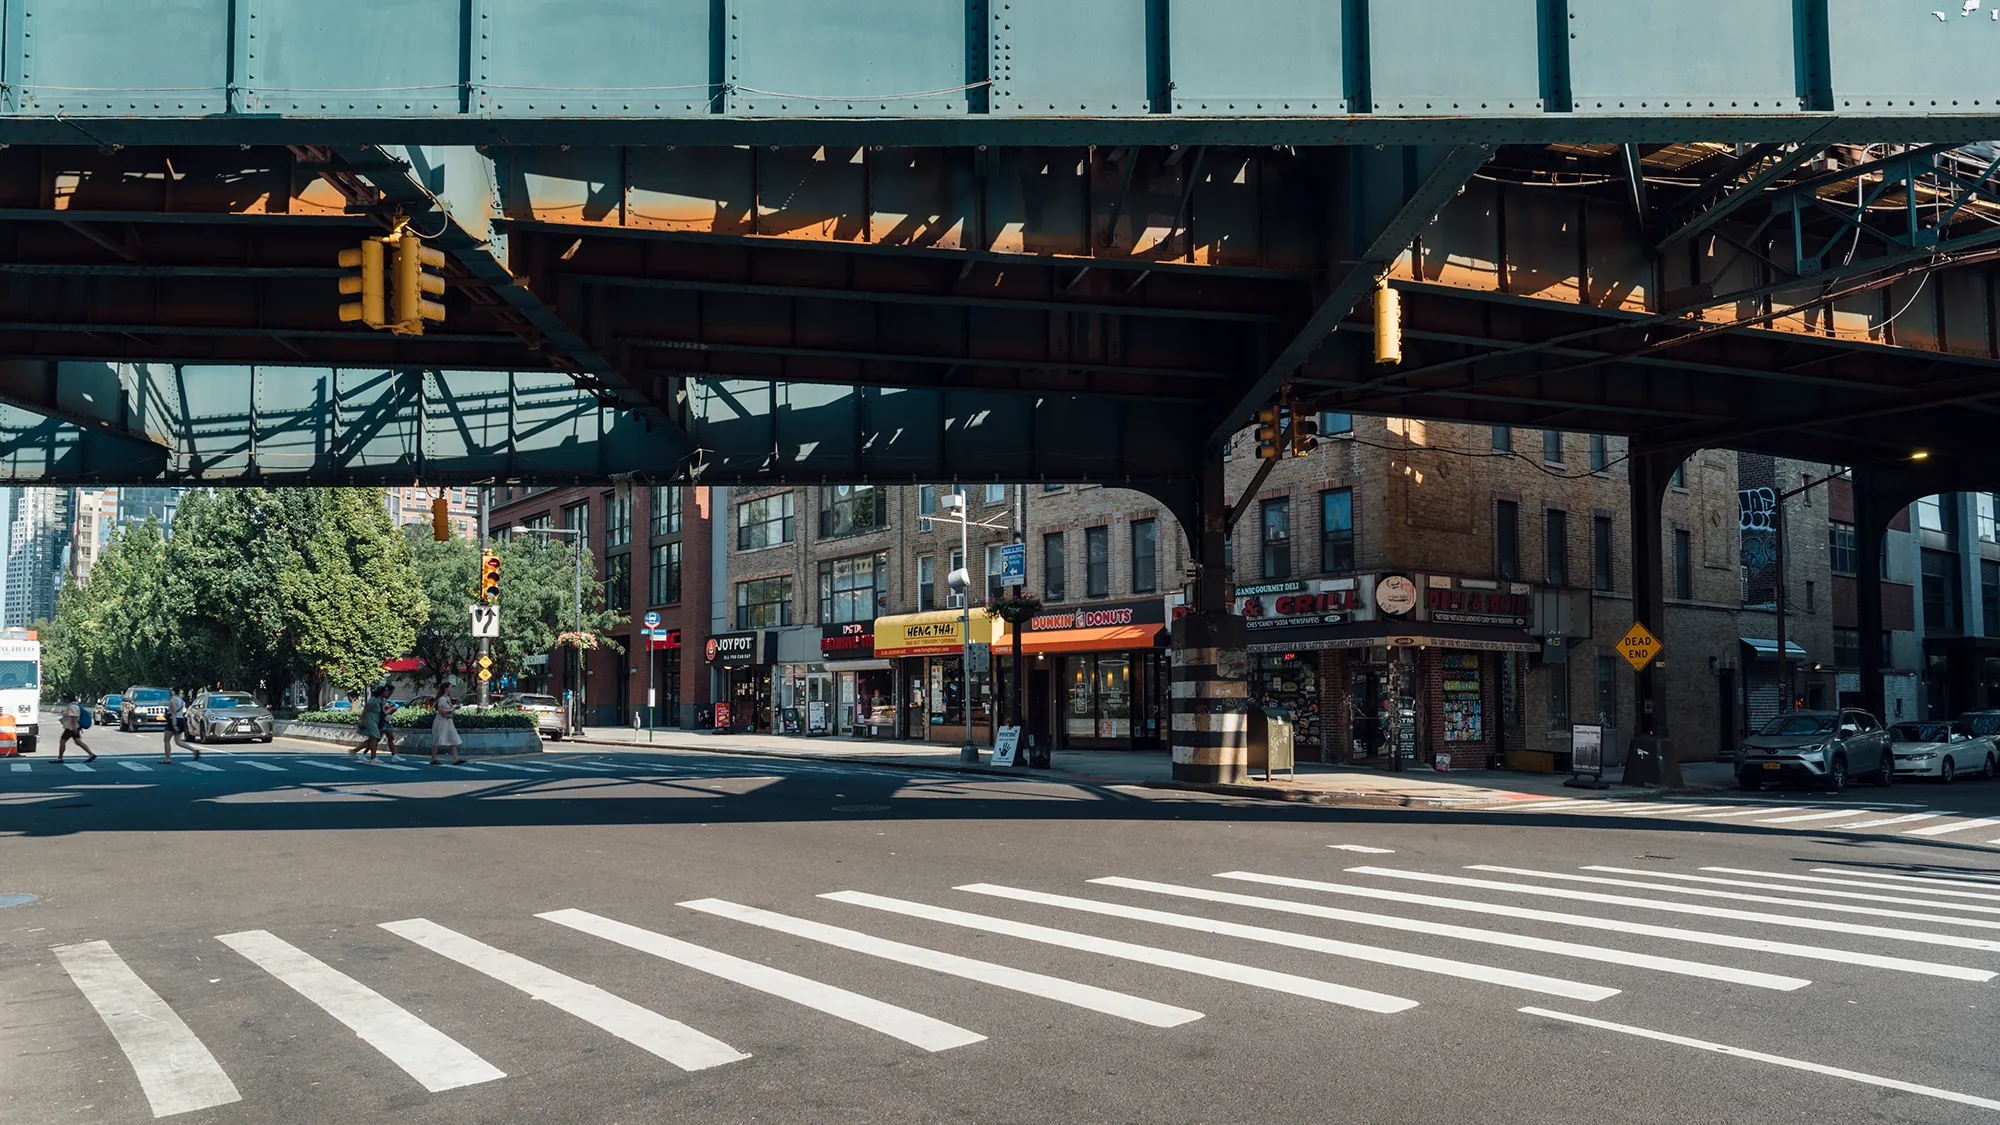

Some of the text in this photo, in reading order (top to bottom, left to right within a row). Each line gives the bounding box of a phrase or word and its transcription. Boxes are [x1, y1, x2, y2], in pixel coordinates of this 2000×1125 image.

[1235, 581, 1299, 596] GANIC GOURMET DELI
[1242, 591, 1360, 617] & GRILL
[1429, 590, 1532, 613] DELI & GRILL
[1031, 609, 1131, 630] DUNKIN' DONUTS
[907, 625, 931, 637] HENG
[717, 637, 752, 651] JOYPOT
[1349, 638, 1375, 647] PRODUCTS
[1625, 637, 1651, 646] DEAD
[1283, 653, 1296, 661] ATM
[1628, 649, 1648, 659] END
